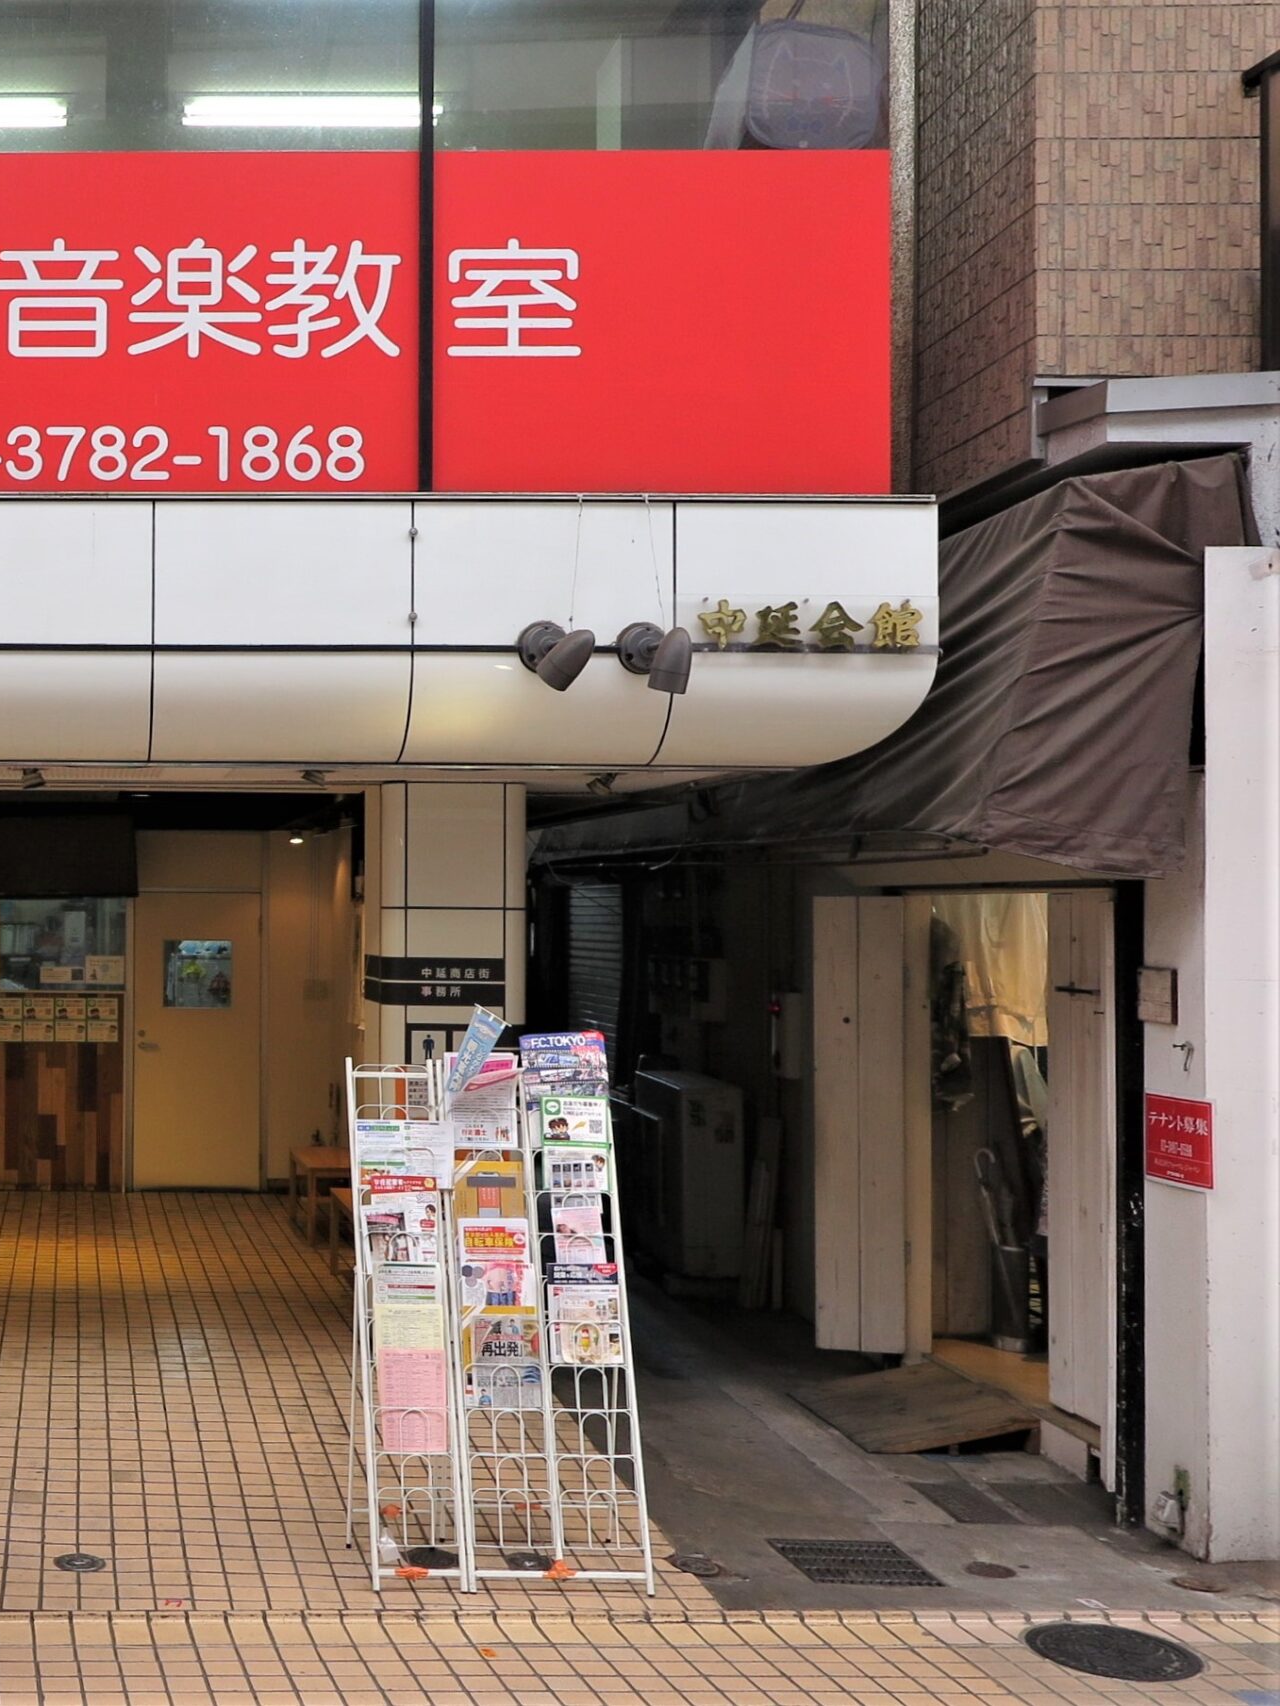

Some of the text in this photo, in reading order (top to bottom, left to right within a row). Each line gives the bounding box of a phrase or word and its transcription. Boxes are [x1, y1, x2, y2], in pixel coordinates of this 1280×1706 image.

[698, 599, 923, 649] 中延会館
[421, 967, 491, 979] 中延商店街
[421, 986, 461, 998] 事務所
[1148, 1112, 1209, 1136] テナント募集
